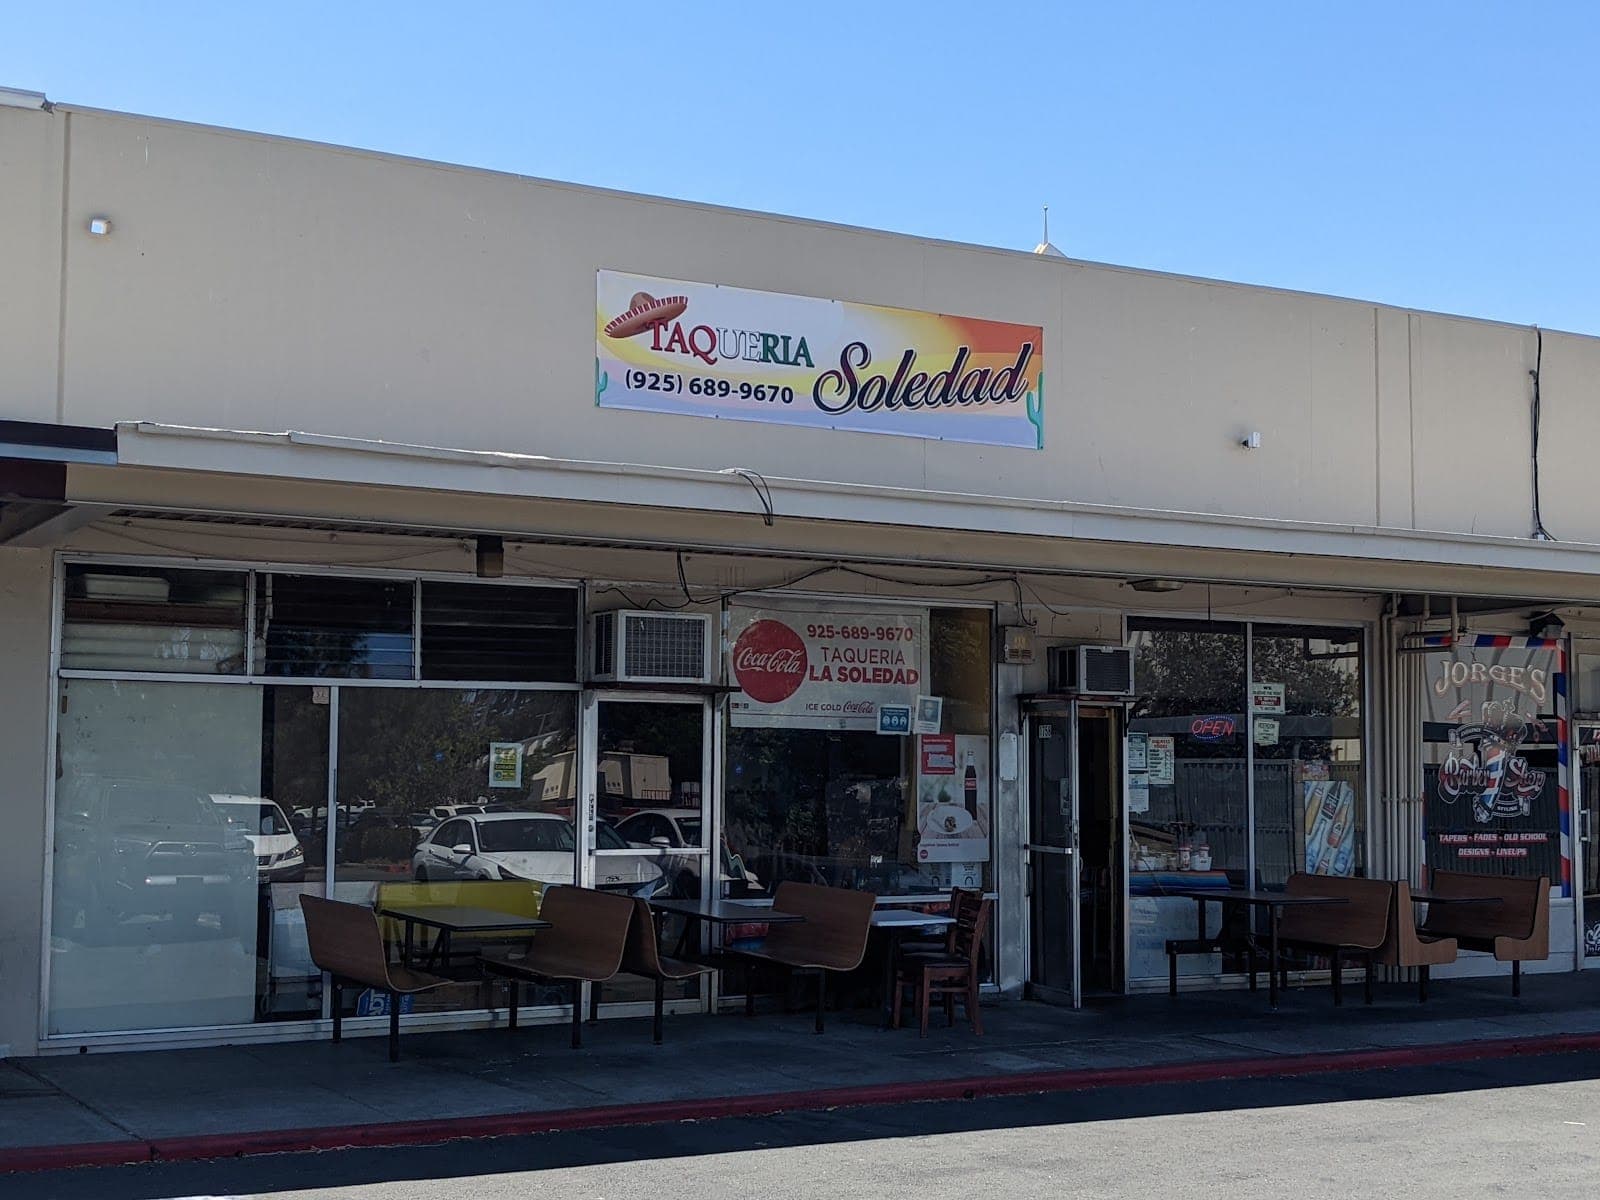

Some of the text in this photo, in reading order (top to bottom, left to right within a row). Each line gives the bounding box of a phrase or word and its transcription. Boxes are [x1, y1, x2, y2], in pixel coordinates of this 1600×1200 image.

[647, 318, 815, 368] TAQUERIA
[625, 369, 794, 404] (925) 689-9670
[812, 341, 1034, 414] Soledad
[807, 624, 914, 642] 925-689-9670
[736, 647, 804, 674] Coca-Cola
[820, 646, 906, 666] TAQUERIA
[809, 665, 919, 685] LA SOLEDAD
[1435, 660, 1546, 704] JORGE'S
[805, 703, 819, 711] ICE
[821, 704, 842, 712] COLD
[1191, 719, 1235, 737] OPEN
[1440, 752, 1546, 796] Barber Shop
[1439, 833, 1548, 844] TAPERS FADES OLD SCHOOL
[1458, 848, 1490, 857] DESIGNS
